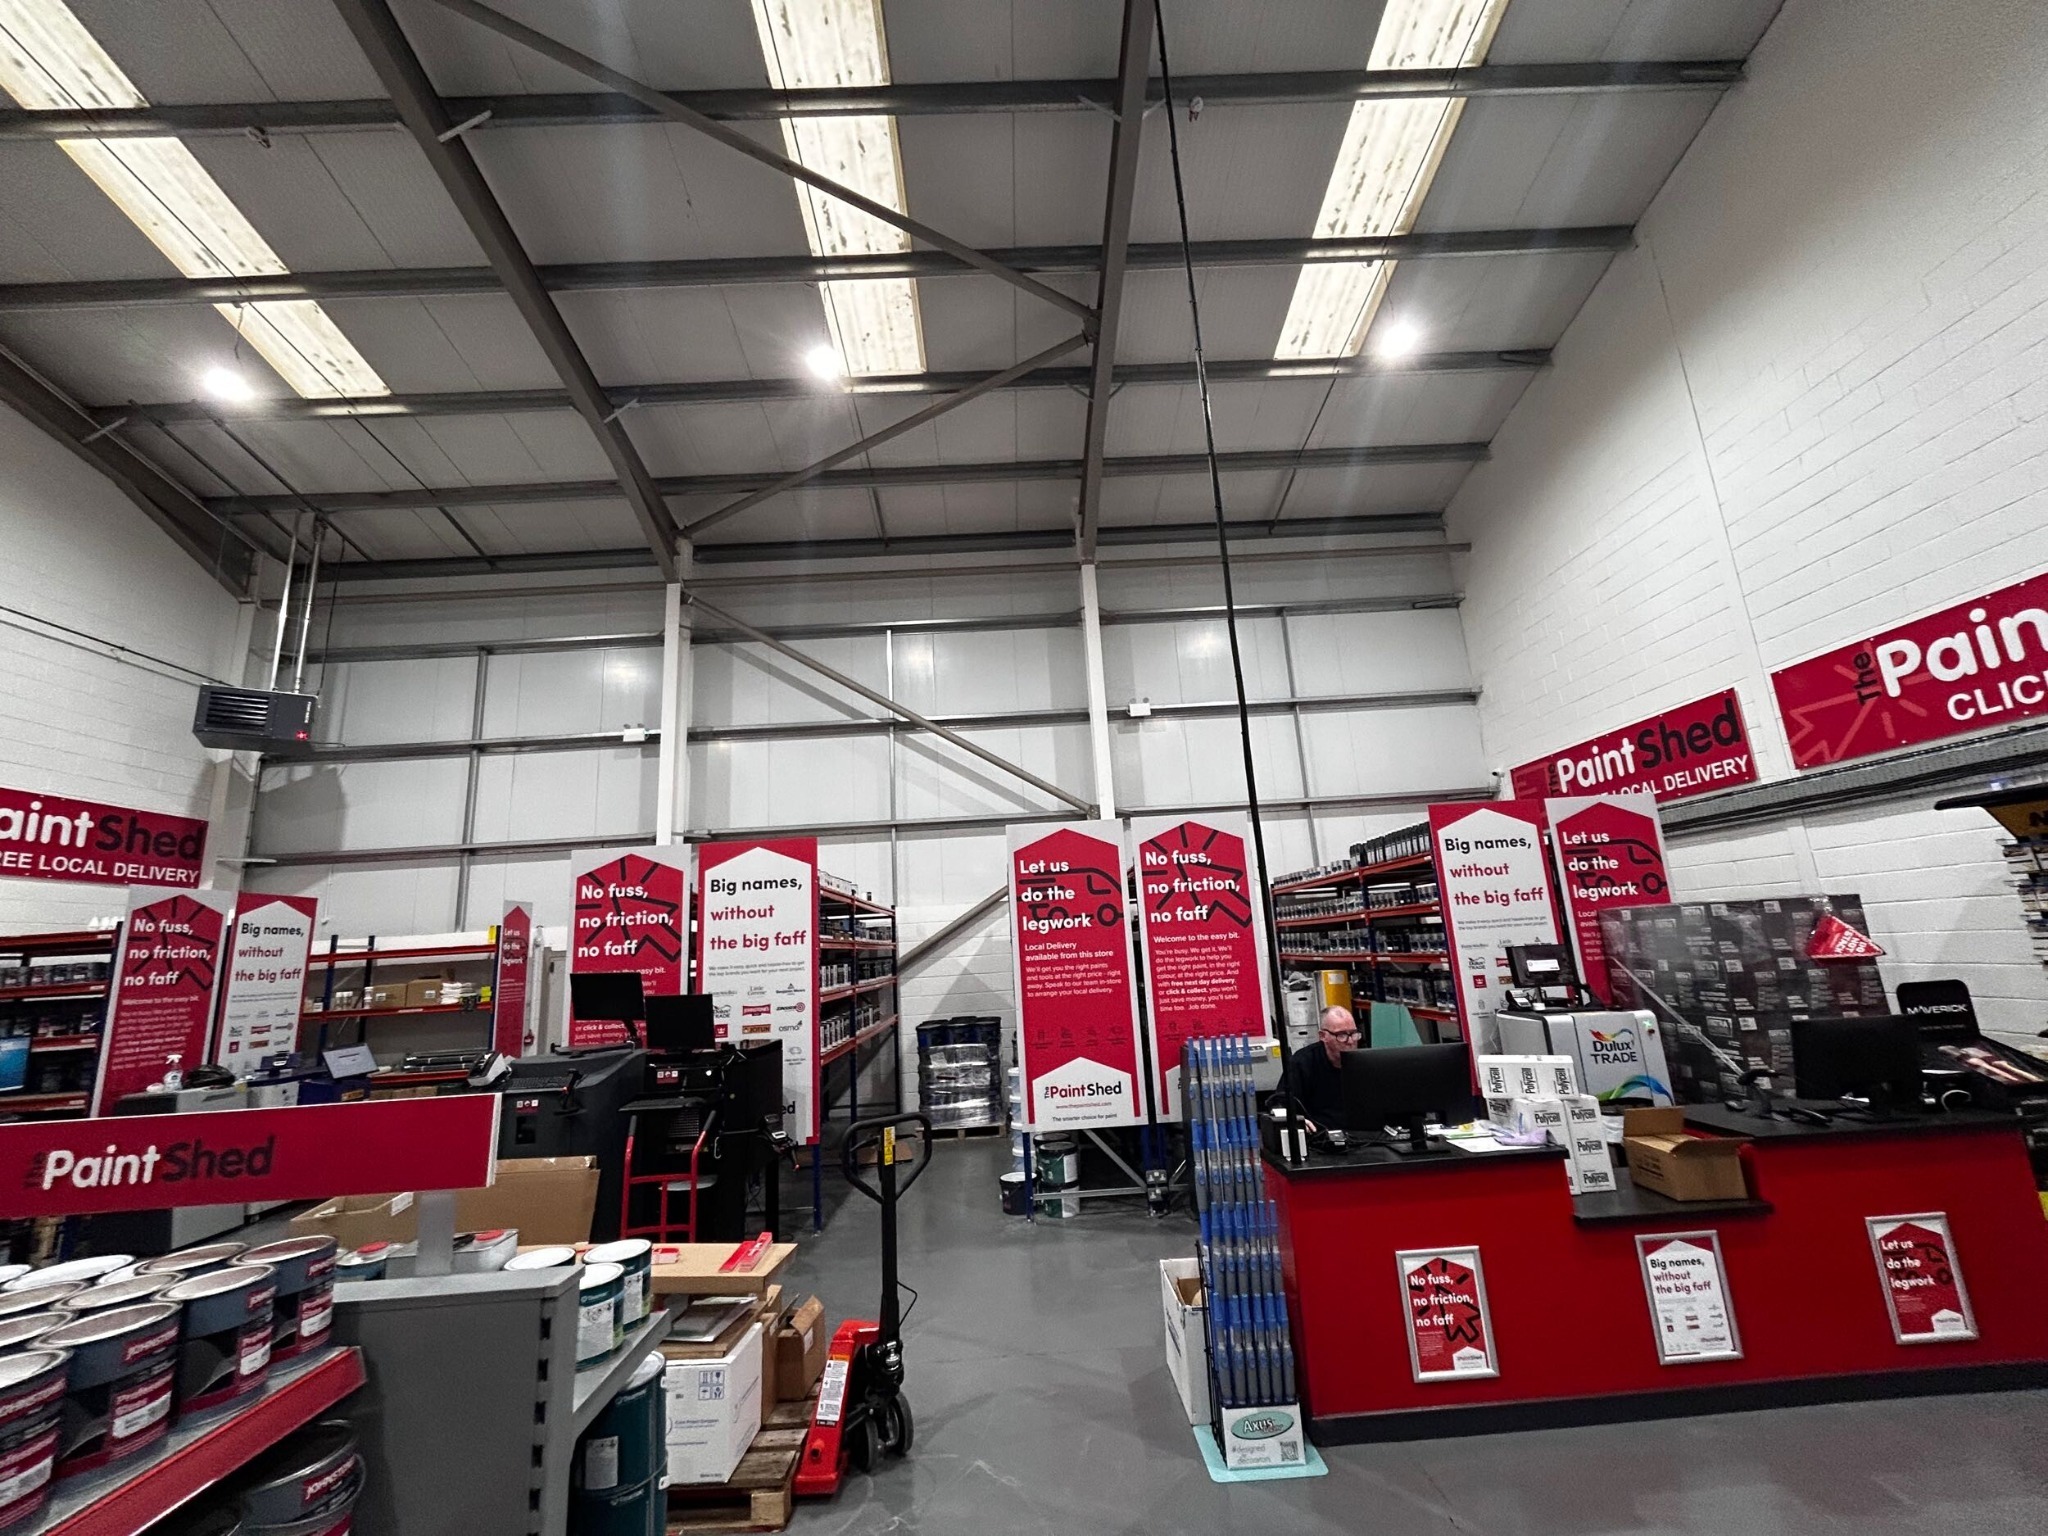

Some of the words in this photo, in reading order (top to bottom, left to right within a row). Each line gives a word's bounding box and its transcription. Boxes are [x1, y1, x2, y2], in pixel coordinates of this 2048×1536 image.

[1875, 607, 2048, 698] Pain
[1947, 669, 2048, 721] CLIC
[1663, 754, 1748, 792] DELIVERY
[1444, 838, 1470, 854] Big
[1474, 837, 1532, 850] names,
[1562, 831, 1588, 845] Let
[1591, 832, 1609, 843] us
[1145, 851, 1168, 866] No
[1171, 850, 1212, 866] fuss,
[1568, 857, 1588, 872] do
[1592, 855, 1619, 869] the
[0, 851, 33, 870] EE
[39, 854, 108, 876] LOCAL
[112, 861, 200, 884] DELIVERY
[1020, 859, 1046, 874] Let
[1049, 861, 1070, 873] us
[1449, 863, 1510, 878] without
[581, 884, 604, 900] No
[608, 883, 649, 899] fuss,
[710, 878, 737, 896] Big
[741, 877, 803, 891] names,
[1147, 883, 1169, 894] no
[1172, 876, 1240, 892] friction,
[1572, 881, 1638, 901] legwork
[1021, 886, 1043, 902] do
[1046, 885, 1076, 900] the
[1454, 892, 1480, 906] the
[1484, 890, 1510, 907] big
[1513, 887, 1544, 903] faff
[579, 917, 602, 928] no
[605, 910, 674, 927] friction,
[710, 904, 775, 921] without
[1150, 912, 1172, 923] no
[1175, 905, 1209, 921] faff
[134, 918, 155, 933] No
[159, 919, 193, 936] fuss,
[241, 923, 260, 936] Big
[263, 923, 304, 937] names,
[1022, 912, 1092, 935] legwork
[710, 936, 738, 950] the
[742, 934, 770, 951] big
[773, 930, 807, 947] faff
[1024, 942, 1045, 951] Local
[1046, 941, 1077, 950] Delivery
[1153, 935, 1187, 944] Welcome
[1210, 933, 1228, 941] easy
[129, 948, 150, 959] no
[153, 945, 212, 961] friction,
[238, 947, 283, 958] without
[578, 945, 600, 957] no
[604, 939, 639, 956] faff
[1025, 952, 1059, 961] available
[1060, 951, 1078, 959] from
[1078, 950, 1093, 958] this
[1094, 950, 1114, 958] store
[124, 974, 145, 986] no
[149, 971, 180, 986] faff
[235, 969, 255, 981] the
[258, 969, 278, 983] big
[280, 967, 302, 980] faff
[1592, 1040, 1632, 1052] Dulux
[1590, 1051, 1638, 1064] TRADE
[1534, 1112, 1562, 1125] Polycell
[1571, 1108, 1596, 1121] Polycell
[1577, 1140, 1603, 1153] Polycell
[1583, 1172, 1610, 1186] Polycell
[1881, 1240, 1899, 1250] Let
[1900, 1240, 1914, 1249] us
[1650, 1258, 1667, 1270] Big
[1668, 1258, 1704, 1267] names,
[1886, 1257, 1901, 1269] do
[1902, 1256, 1921, 1268] the
[1410, 1275, 1426, 1286] No
[1427, 1273, 1454, 1285] fuss,
[1653, 1270, 1691, 1281] without
[1890, 1274, 1937, 1290] legwork
[1656, 1284, 1672, 1294] the
[1674, 1282, 1691, 1295] big
[1692, 1280, 1711, 1291] faff
[1413, 1297, 1428, 1306] no
[1430, 1292, 1474, 1305] friction,
[1416, 1317, 1431, 1327] no
[1432, 1313, 1454, 1326] faff
[1243, 1417, 1275, 1434] Axus
